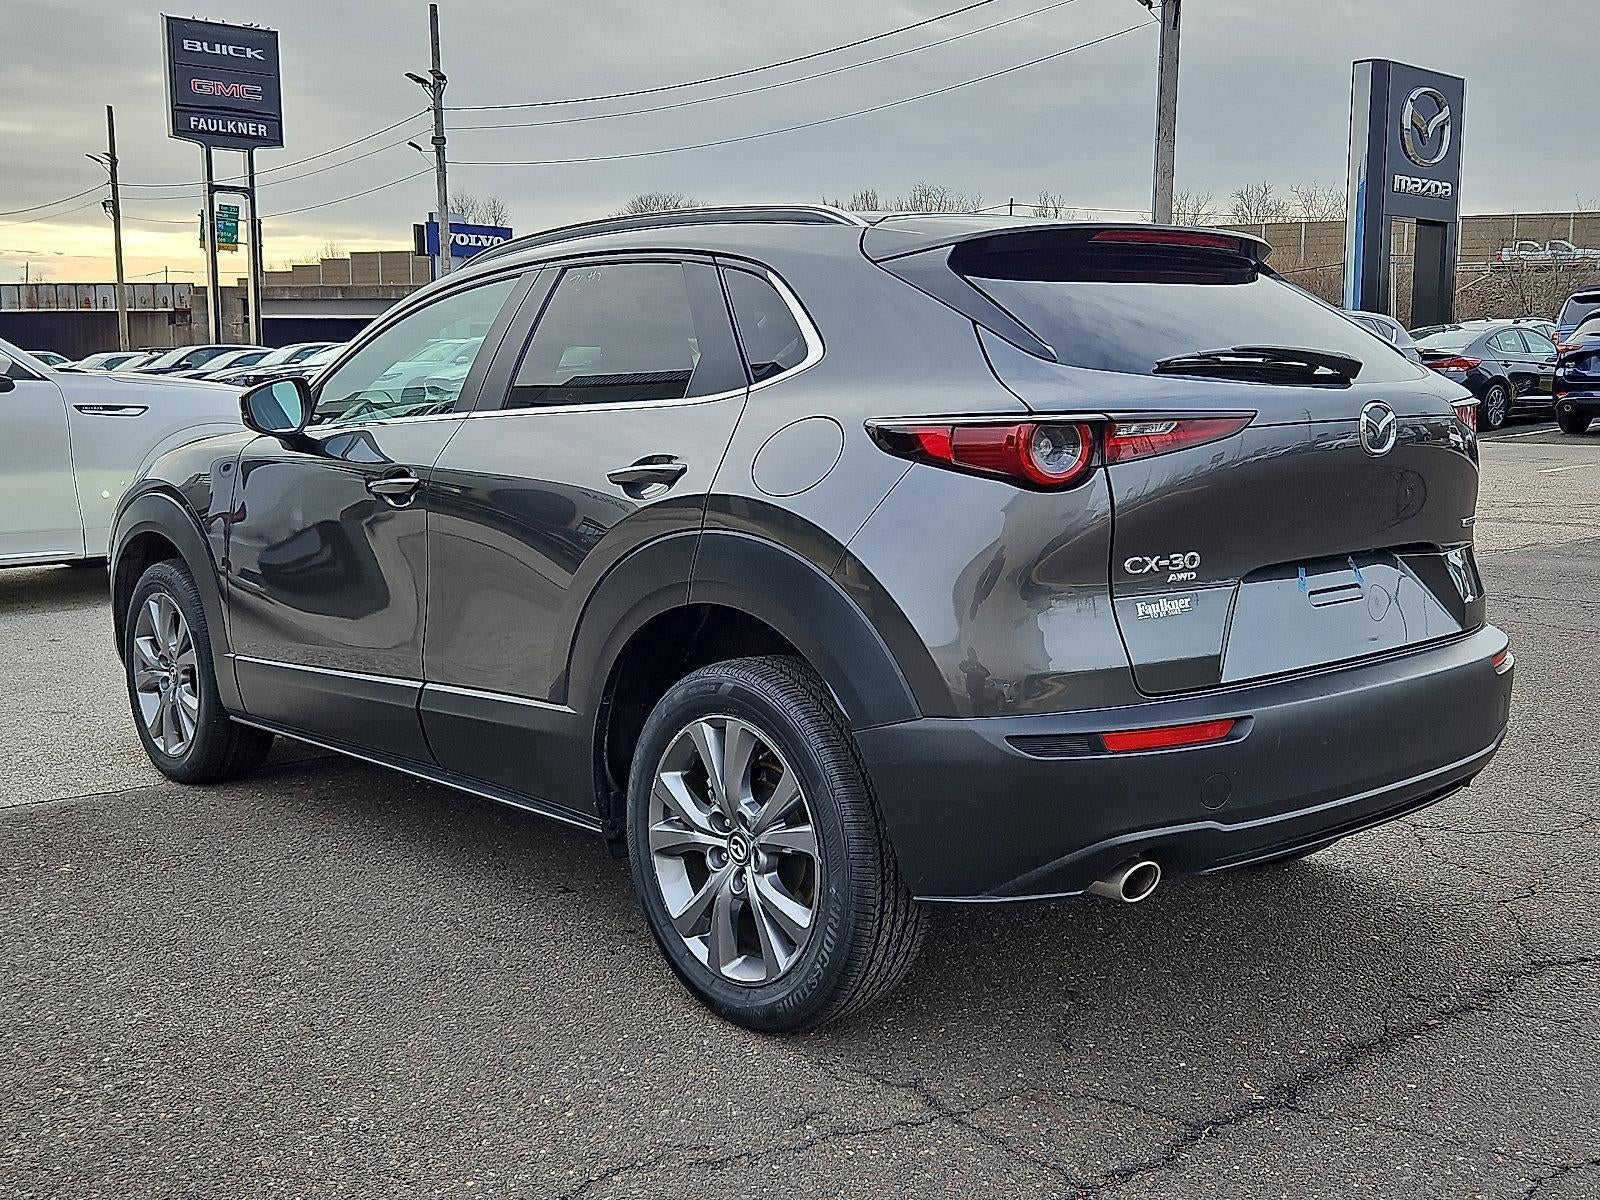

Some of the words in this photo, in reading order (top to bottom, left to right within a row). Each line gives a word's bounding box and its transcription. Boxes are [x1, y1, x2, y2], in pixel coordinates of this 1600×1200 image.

[183, 39, 265, 60] BUICK
[190, 79, 263, 101] GMC
[189, 116, 268, 137] FAULKNER
[1123, 551, 1200, 575] CX-30
[1166, 571, 1197, 583] AWD
[1135, 598, 1191, 617] Faulkner
